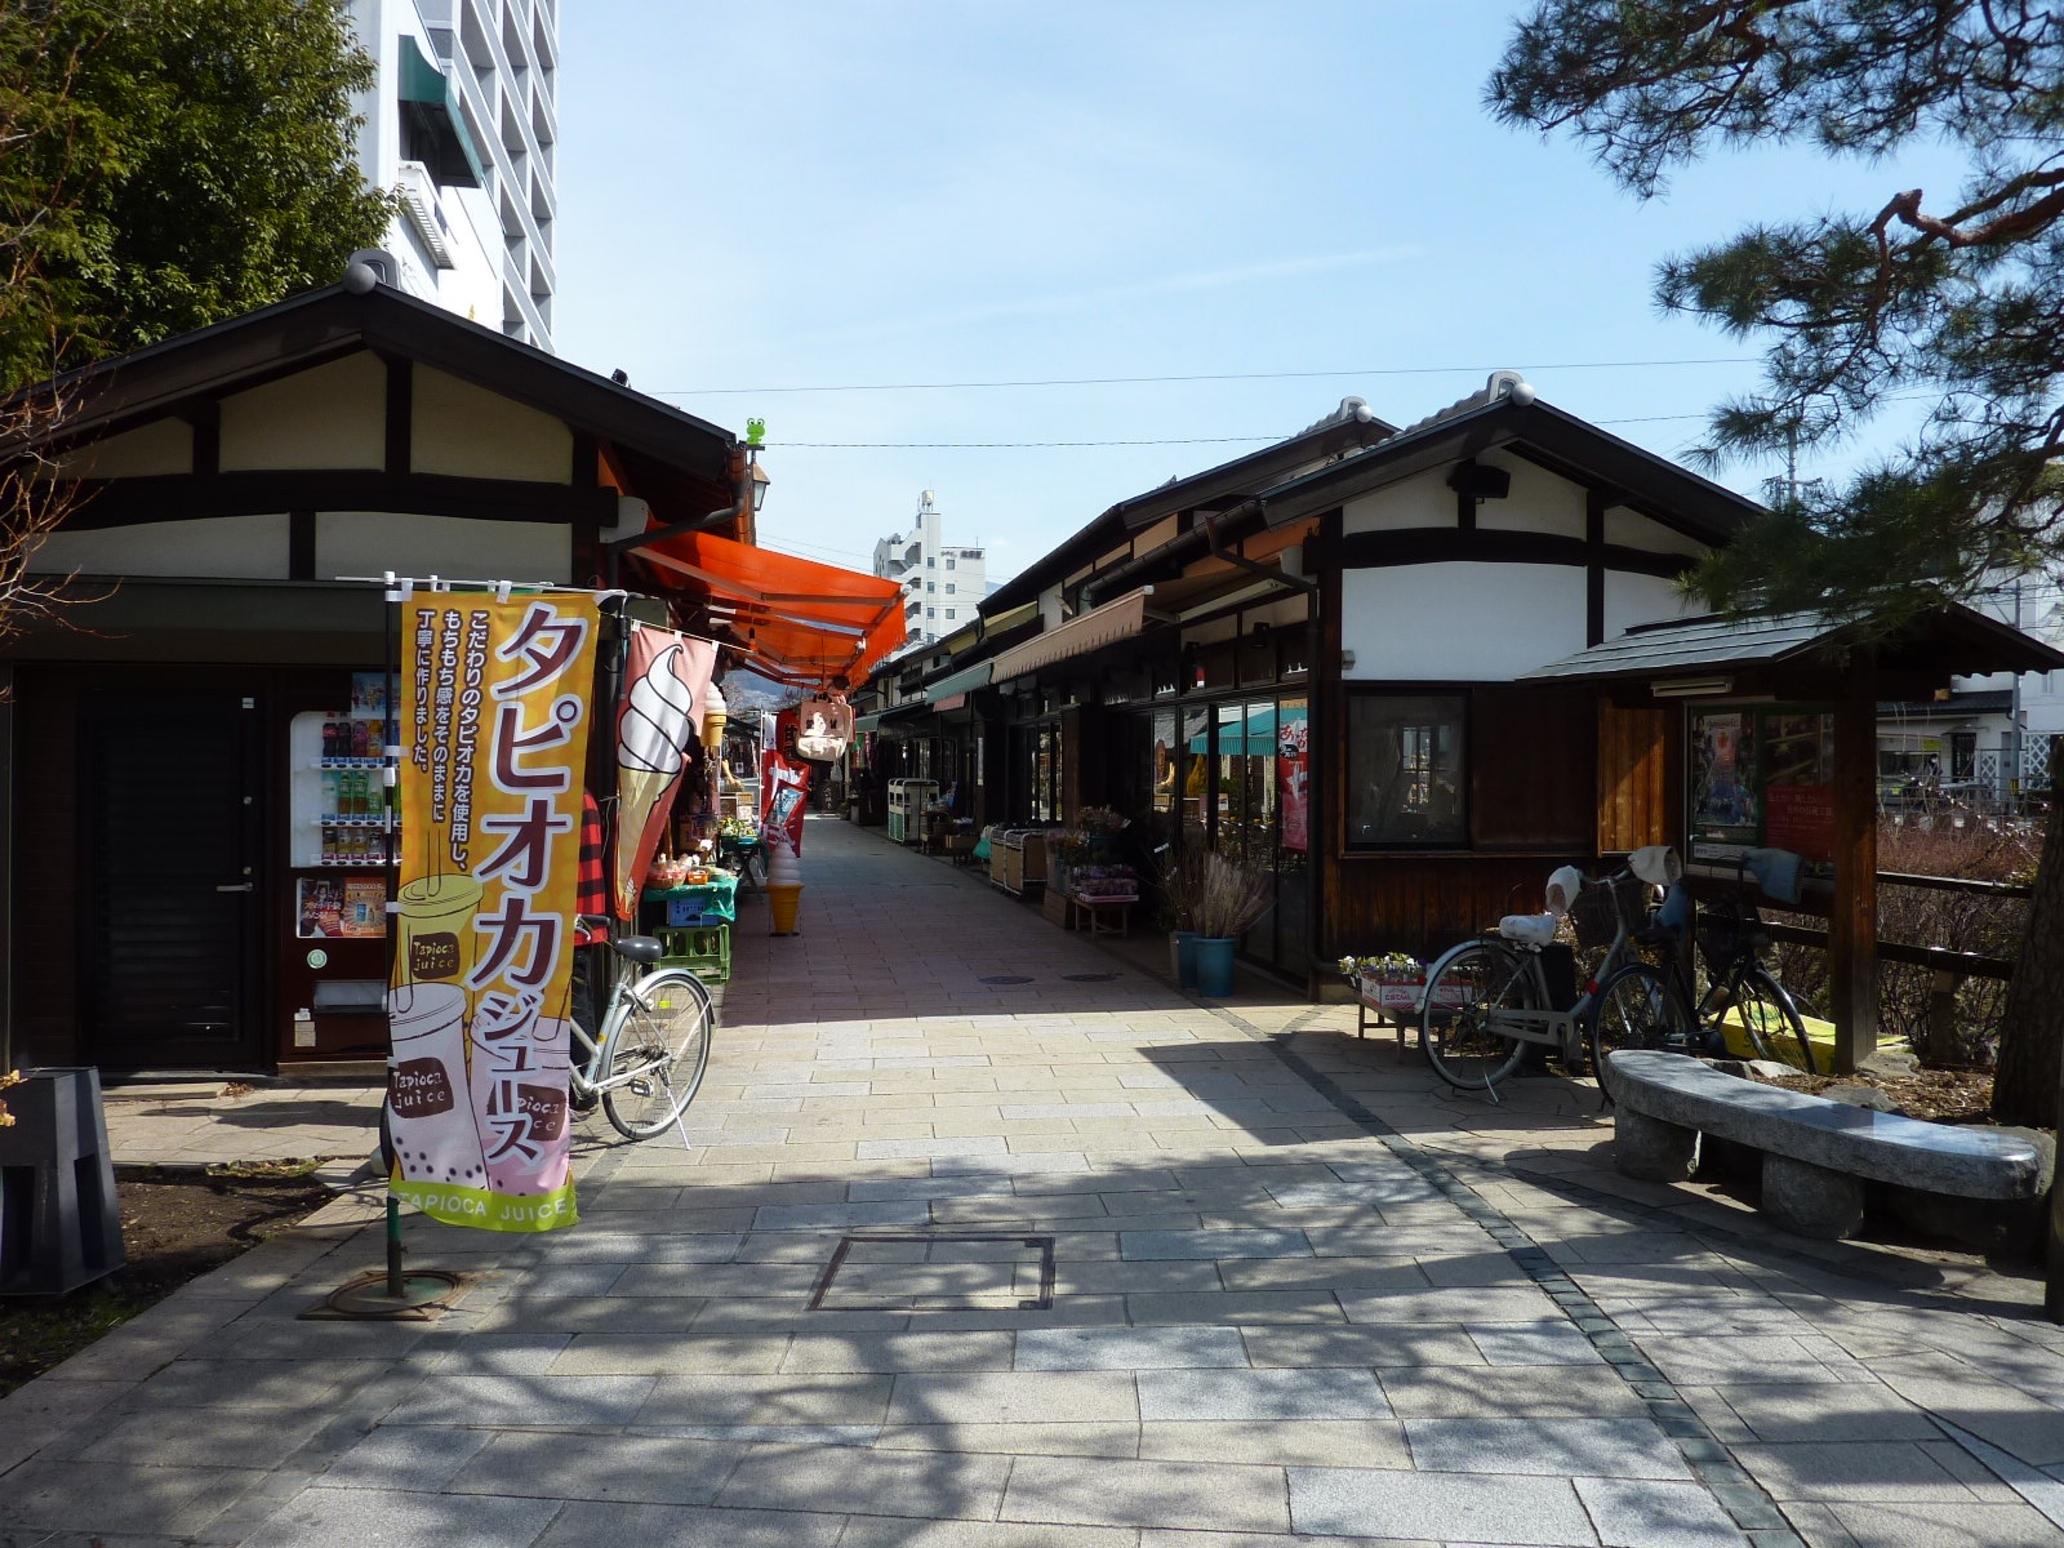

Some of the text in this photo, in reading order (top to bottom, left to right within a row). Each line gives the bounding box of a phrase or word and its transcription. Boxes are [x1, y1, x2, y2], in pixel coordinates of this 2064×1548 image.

[413, 610, 436, 772] 丁寧に作りました。
[432, 610, 461, 822] もちもち感をそのままに
[450, 611, 489, 870] こだわりのタピオカを使用し、
[470, 606, 584, 1163] タピオカジュース
[413, 941, 455, 957] Tapioca
[413, 956, 454, 971] juice
[393, 1070, 443, 1090] Tapioca
[394, 1090, 445, 1109] juice
[500, 1197, 568, 1222] JUICE
